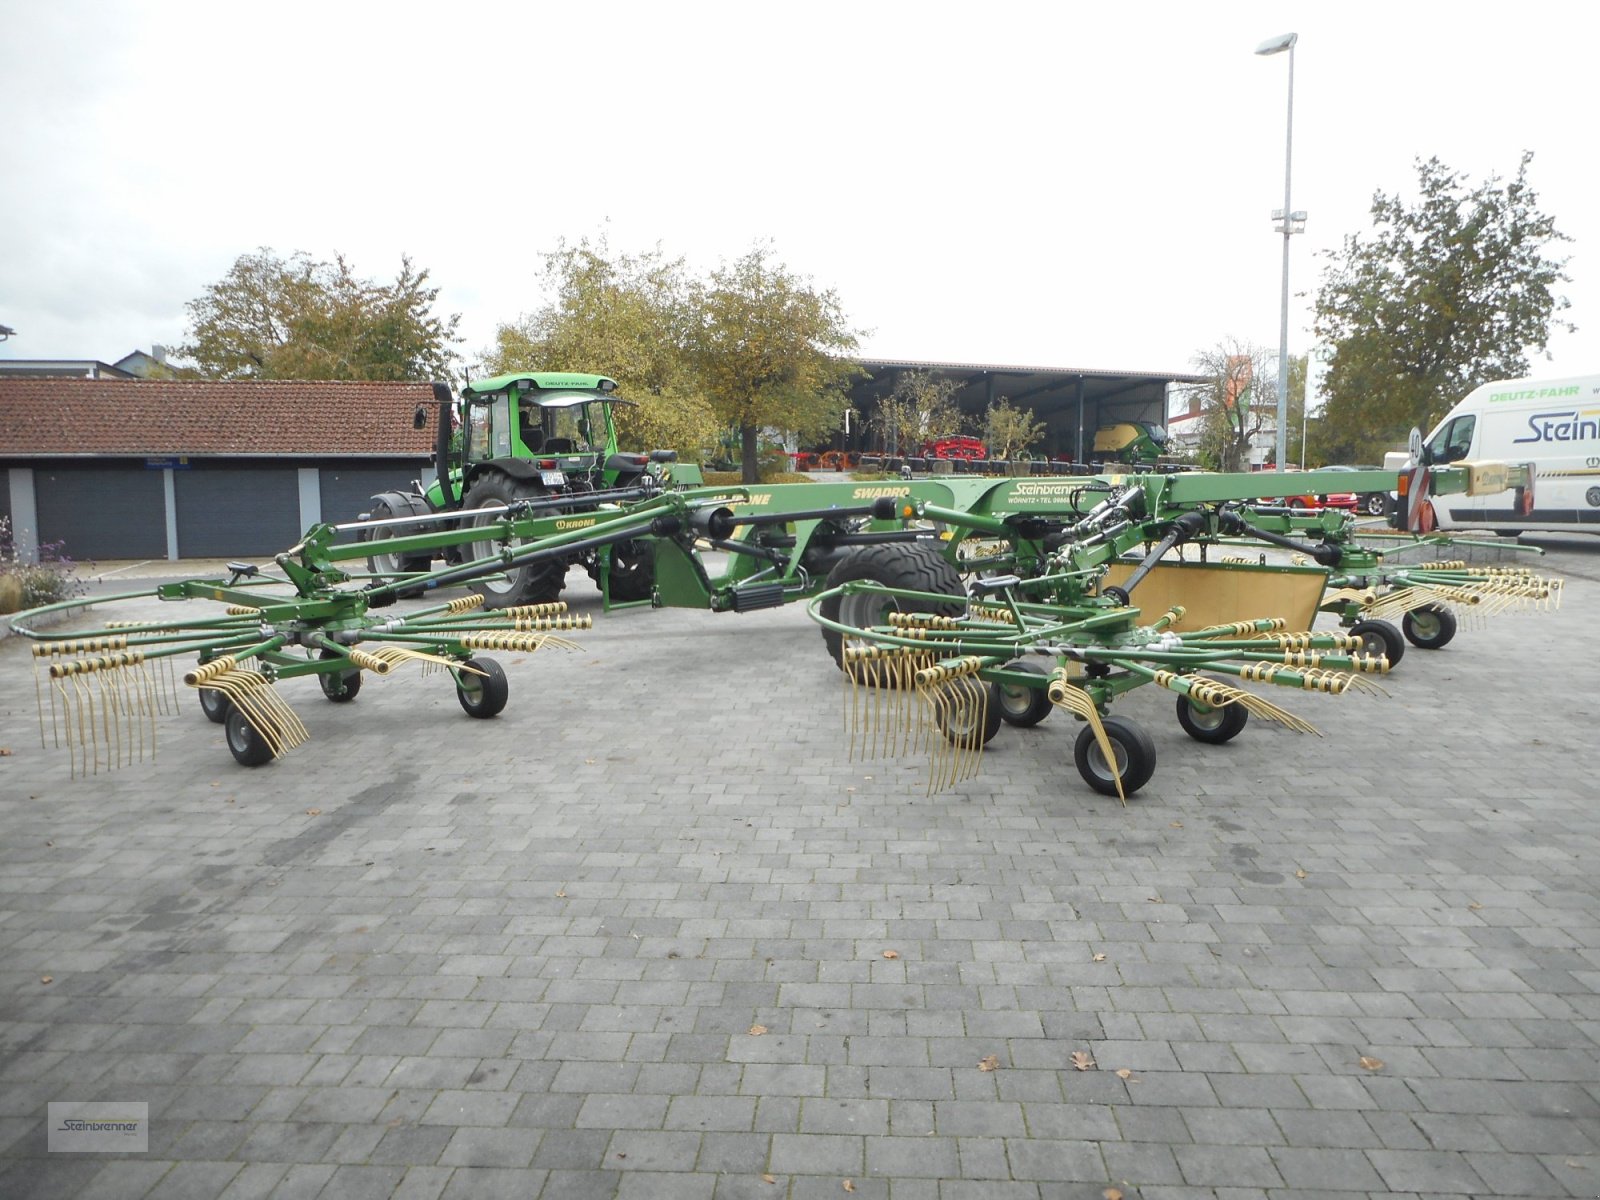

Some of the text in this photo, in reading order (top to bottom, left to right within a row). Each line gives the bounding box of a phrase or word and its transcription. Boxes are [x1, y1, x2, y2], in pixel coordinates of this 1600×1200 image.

[1512, 411, 1600, 443] Stein
[1411, 434, 1420, 460] 40
[853, 487, 910, 499] SWADRO
[1008, 496, 1035, 504] WÖRNITZ
[566, 518, 596, 529] KRONE
